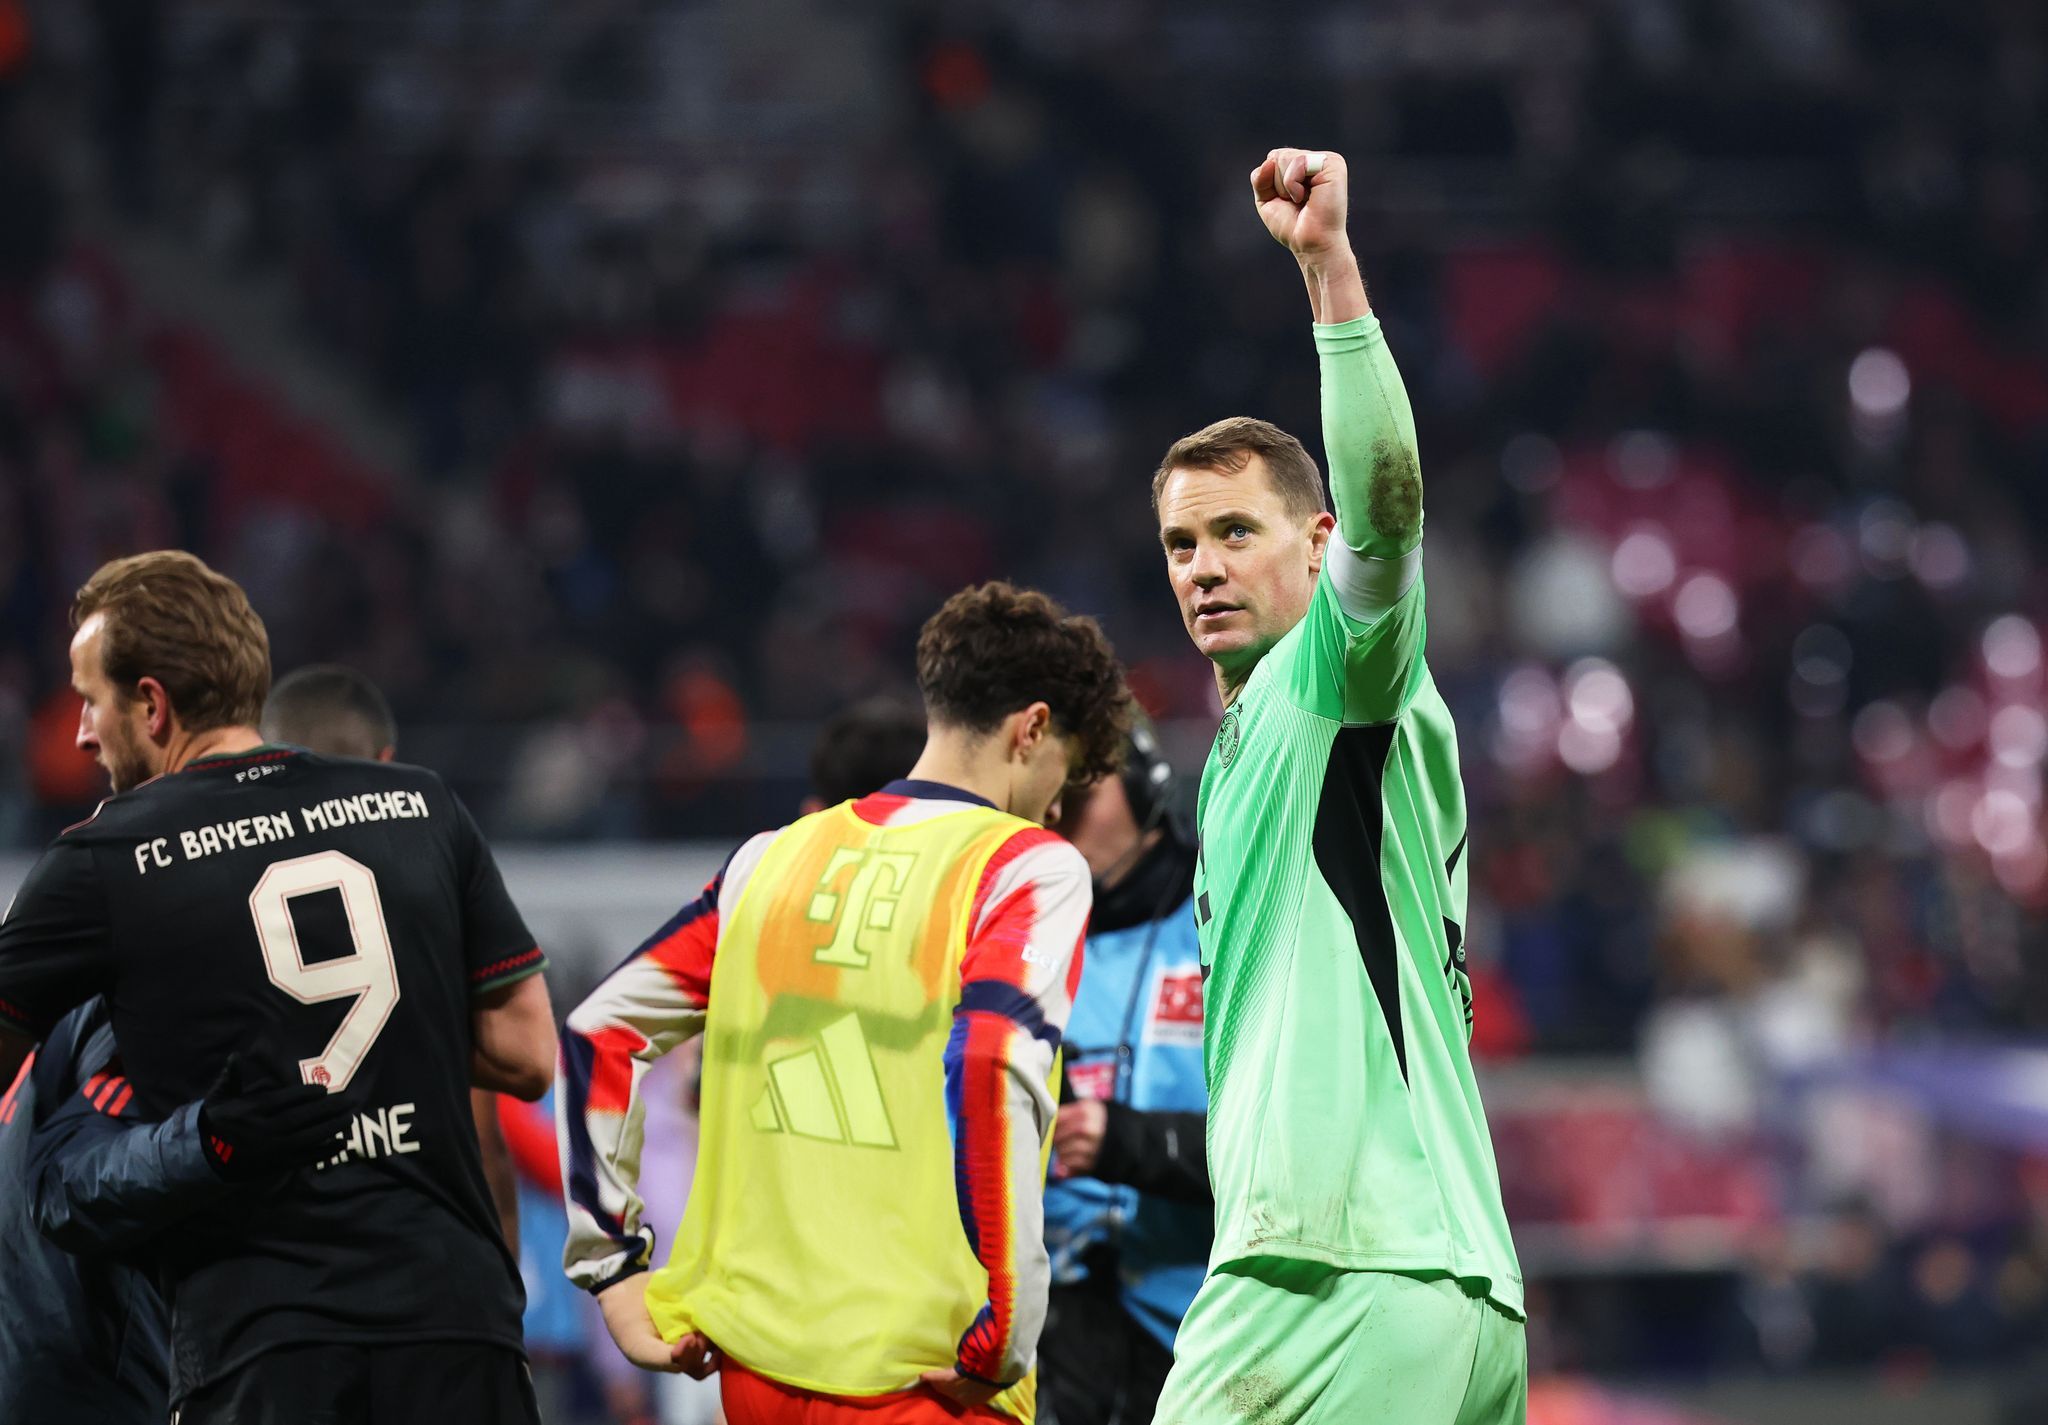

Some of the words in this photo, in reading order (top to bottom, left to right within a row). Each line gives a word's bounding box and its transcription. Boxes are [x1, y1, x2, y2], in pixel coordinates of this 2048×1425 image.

[134, 838, 173, 874] FC
[180, 811, 295, 860] BAYERN
[301, 791, 430, 833] MÜNCHEN
[249, 849, 400, 1095] 9
[316, 1102, 421, 1170] ANE
